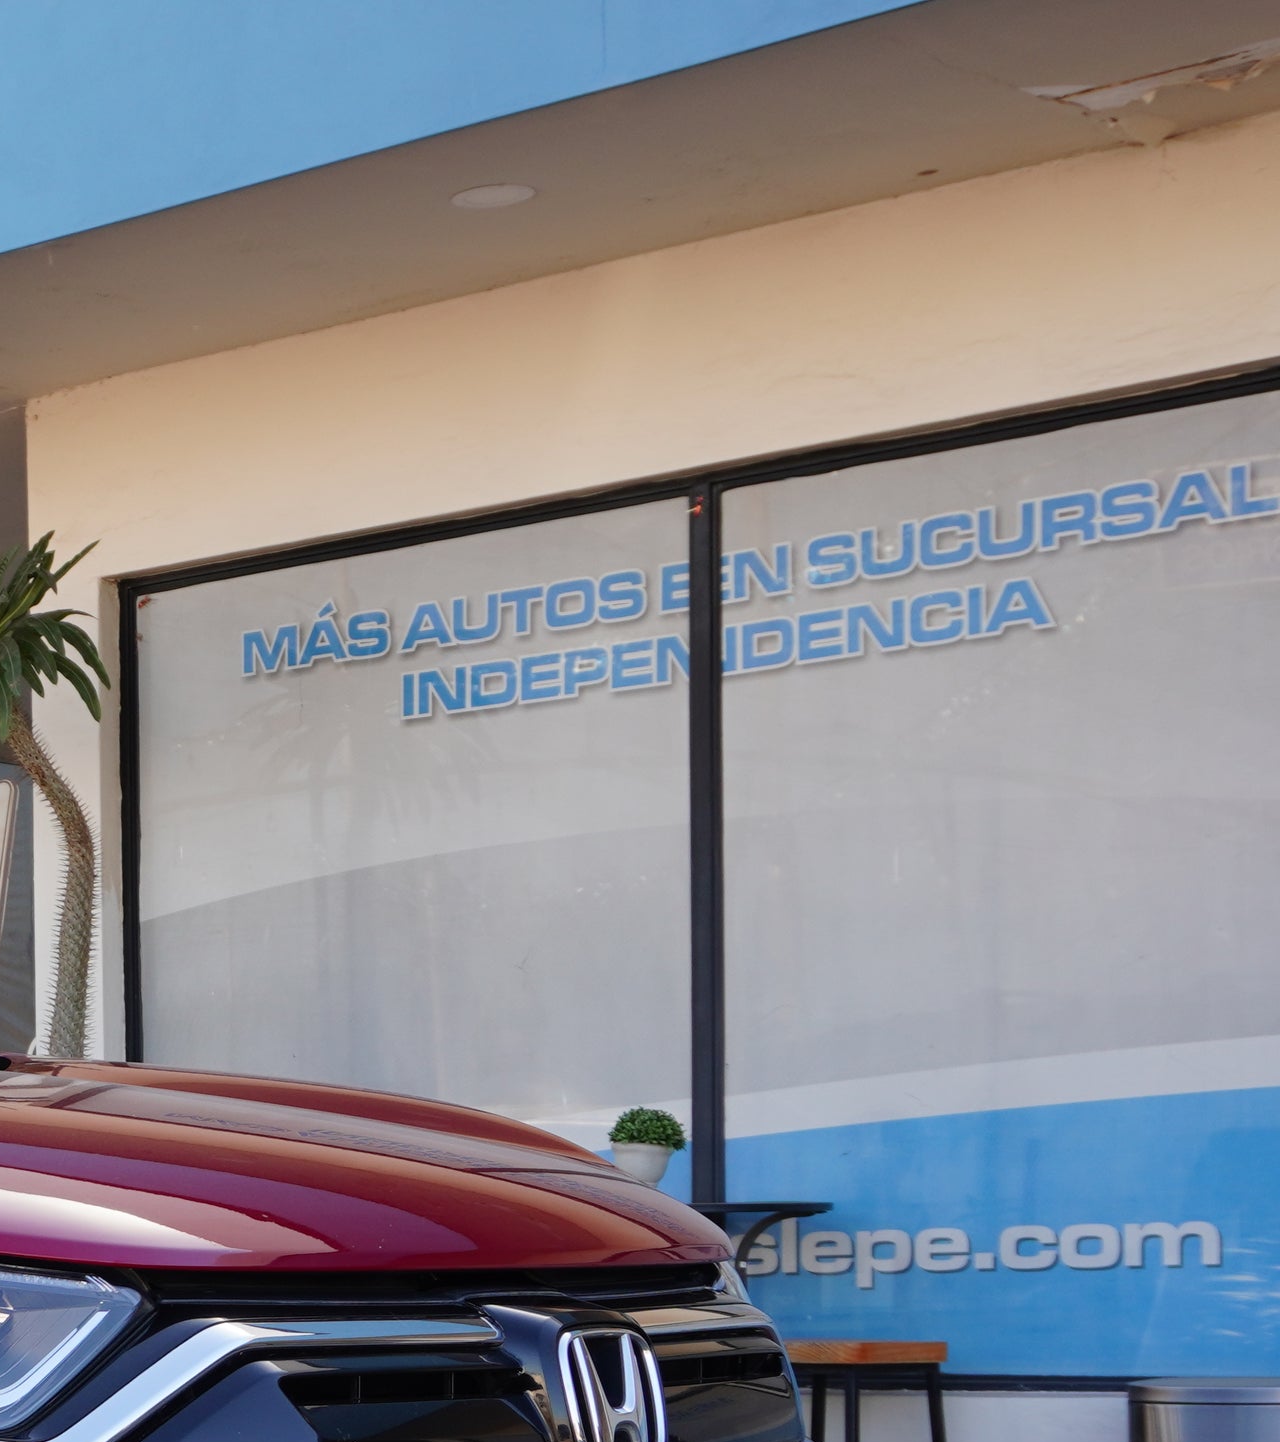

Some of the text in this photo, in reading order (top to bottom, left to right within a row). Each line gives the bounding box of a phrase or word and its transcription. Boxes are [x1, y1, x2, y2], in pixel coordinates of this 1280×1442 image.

[242, 462, 1280, 676] MÁS AUTOS EN SUCURSAL
[400, 577, 1056, 720] INDEPENDENCIA
